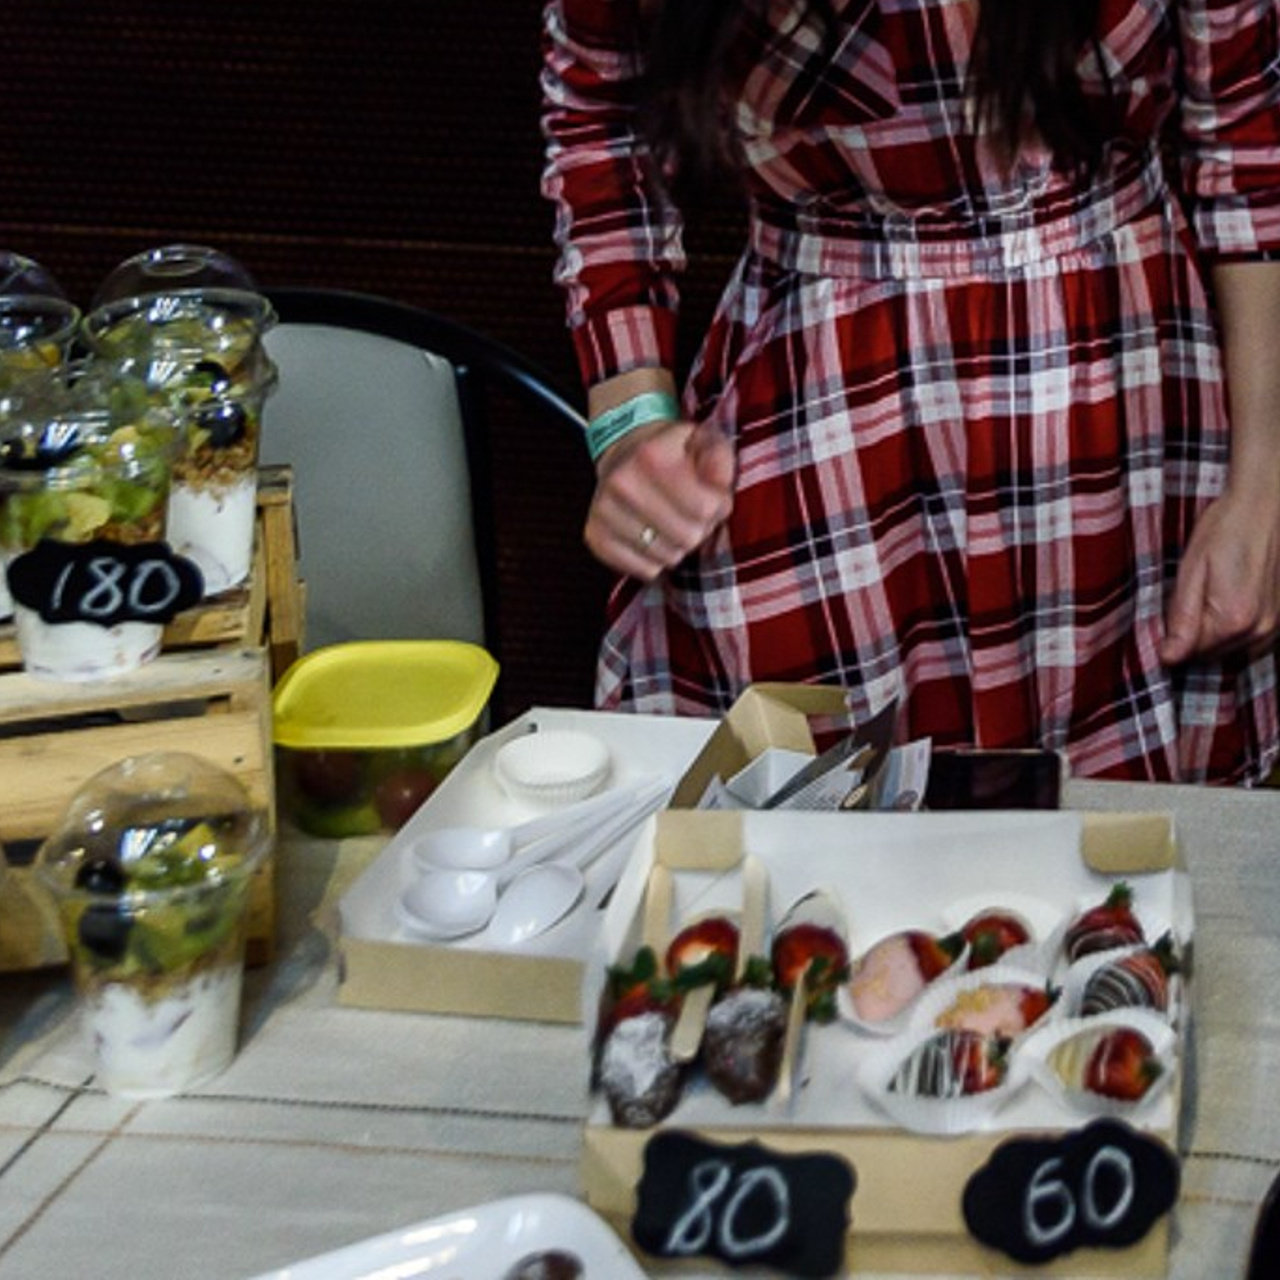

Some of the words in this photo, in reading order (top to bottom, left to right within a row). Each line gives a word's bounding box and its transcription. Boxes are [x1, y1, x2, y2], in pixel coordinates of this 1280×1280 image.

[50, 557, 182, 616] 180
[665, 1158, 792, 1256] 80
[1023, 1143, 1136, 1245] 60
